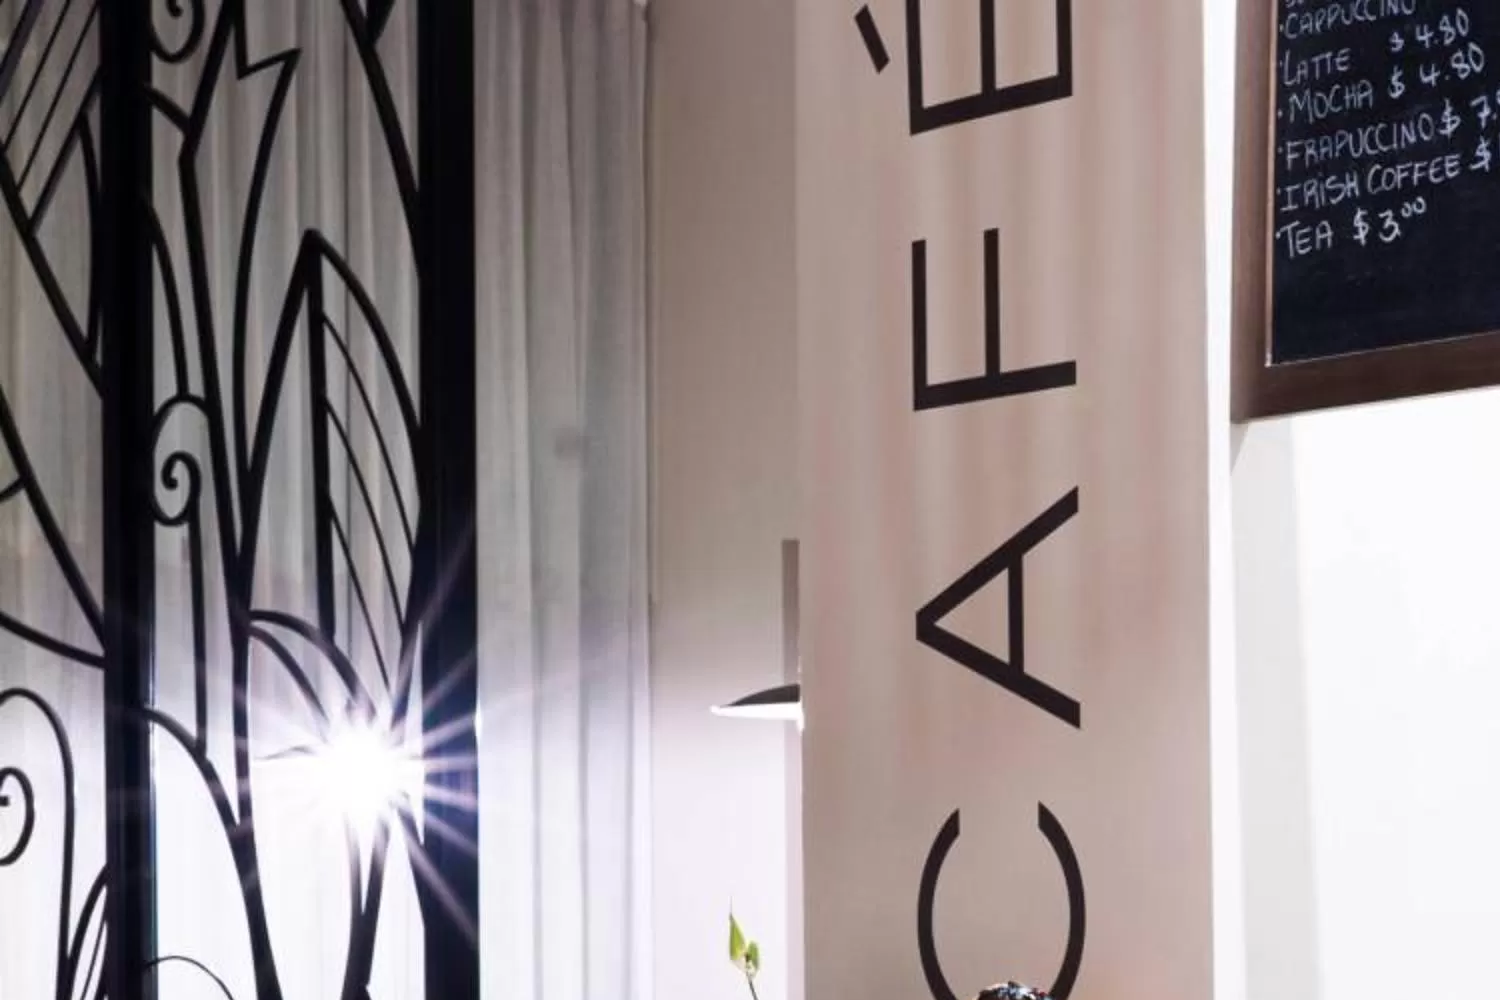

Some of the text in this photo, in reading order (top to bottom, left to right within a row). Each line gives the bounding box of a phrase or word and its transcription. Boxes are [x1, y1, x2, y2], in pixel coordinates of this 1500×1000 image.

[1284, 49, 1351, 86] LATTE
[1288, 79, 1374, 124] MOCHA
[1286, 112, 1434, 170] FRAPUCCINO
[1366, 153, 1461, 195] COFFEE
[1279, 219, 1334, 259] TEA
